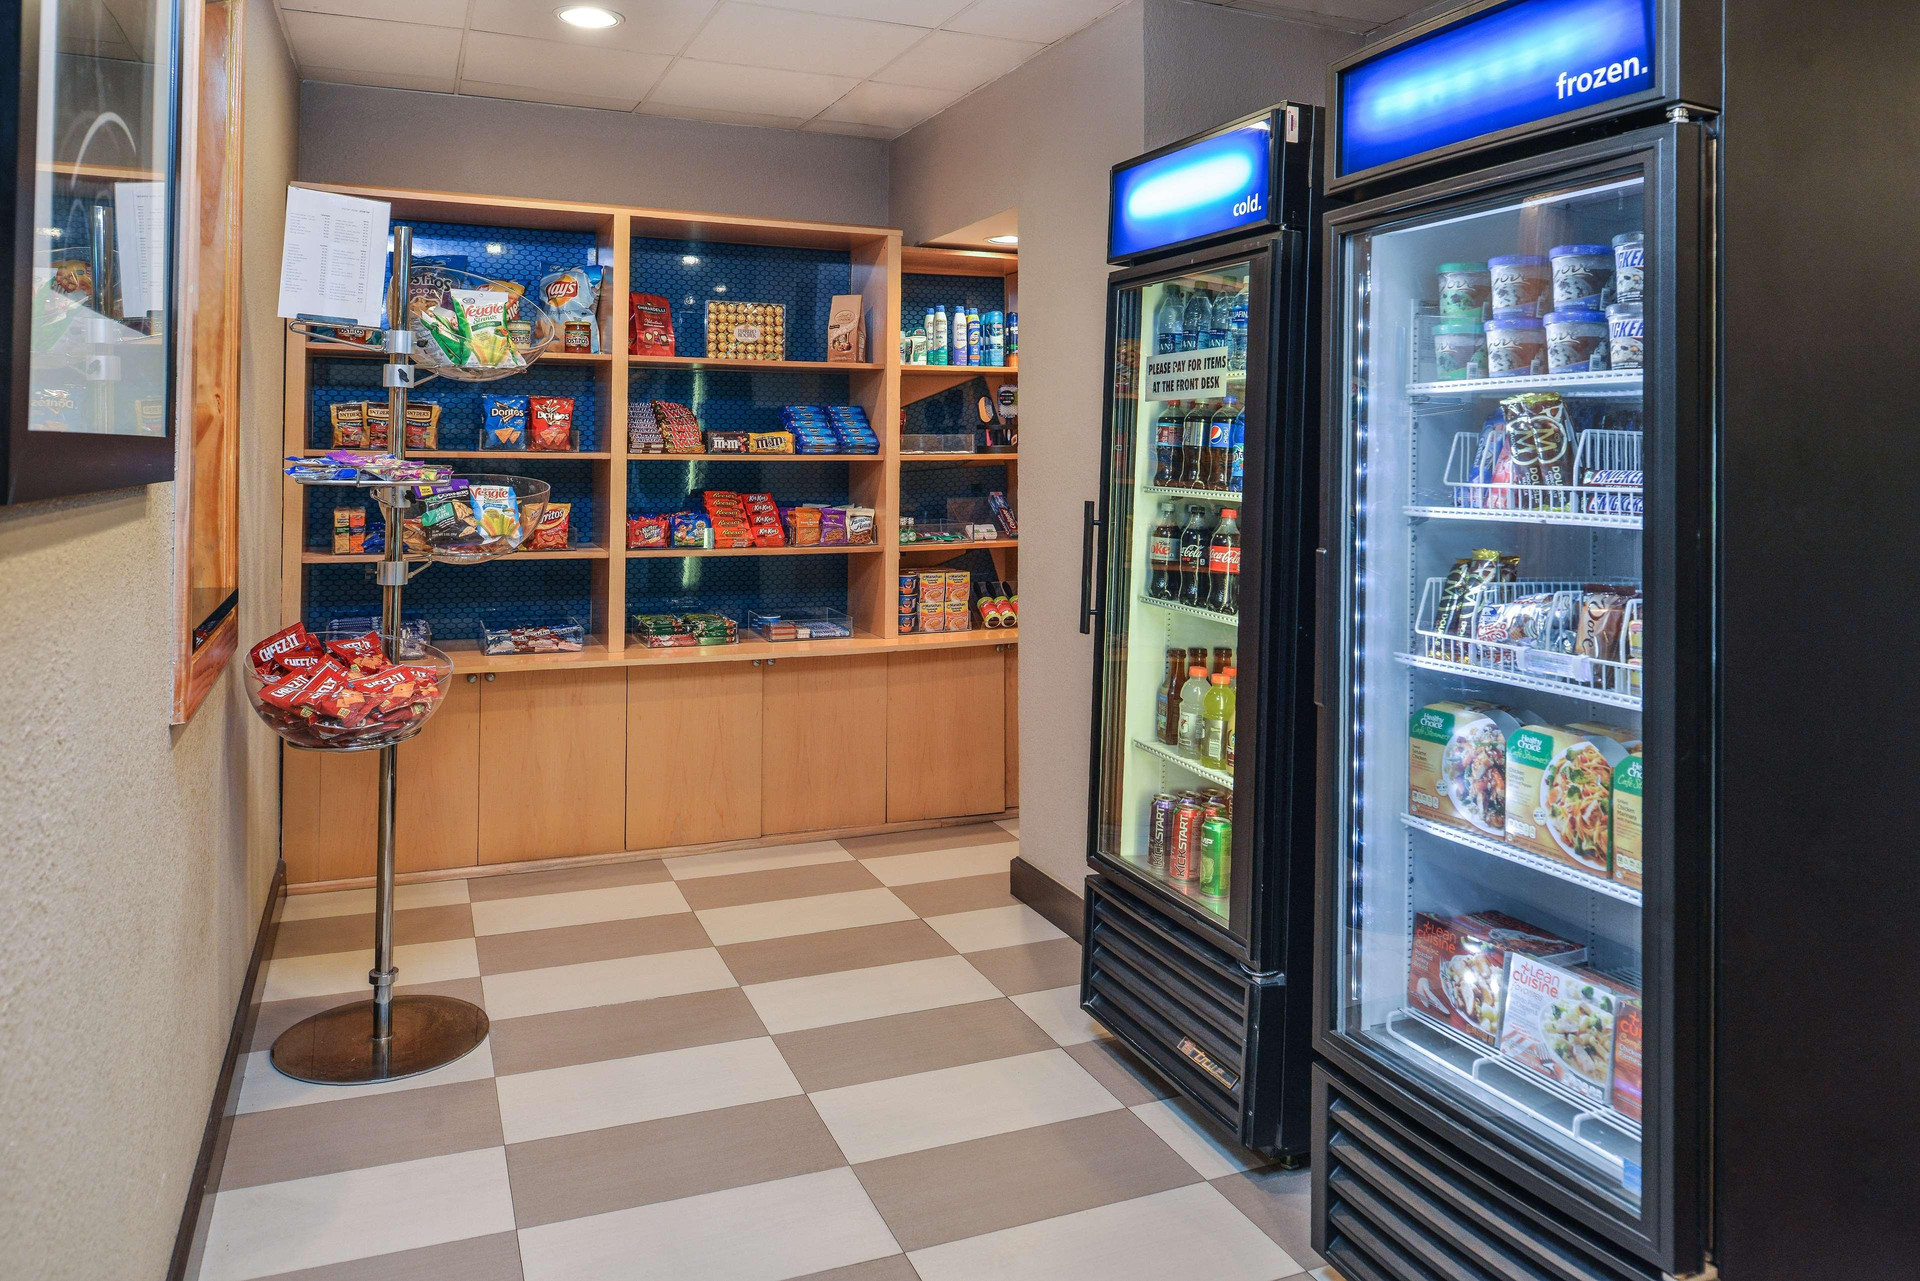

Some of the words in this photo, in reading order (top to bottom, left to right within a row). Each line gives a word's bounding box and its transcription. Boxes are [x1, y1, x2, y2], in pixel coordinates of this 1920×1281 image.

[1555, 56, 1648, 100] frozen.
[1232, 193, 1262, 217] cold.
[462, 303, 505, 318] Veggie
[1148, 361, 1172, 376] PLEASE
[1173, 360, 1186, 373] PAY
[1187, 358, 1202, 371] FOR
[1203, 355, 1227, 370] ITEMS
[1152, 381, 1161, 393] AT
[1162, 380, 1174, 392] THE
[1176, 377, 1199, 391] FRONT
[1201, 375, 1220, 389] DESK
[491, 408, 524, 417] Doritos
[537, 411, 570, 421] Doritos
[469, 487, 509, 499] Veggie
[1151, 541, 1171, 555] oke
[1420, 717, 1443, 729] Choice
[1424, 712, 1445, 724] Healthy
[1517, 739, 1541, 752] Choice
[1521, 733, 1543, 746] Healthy
[1152, 804, 1166, 868] KICKSTART
[1176, 814, 1189, 877] KICKSTART
